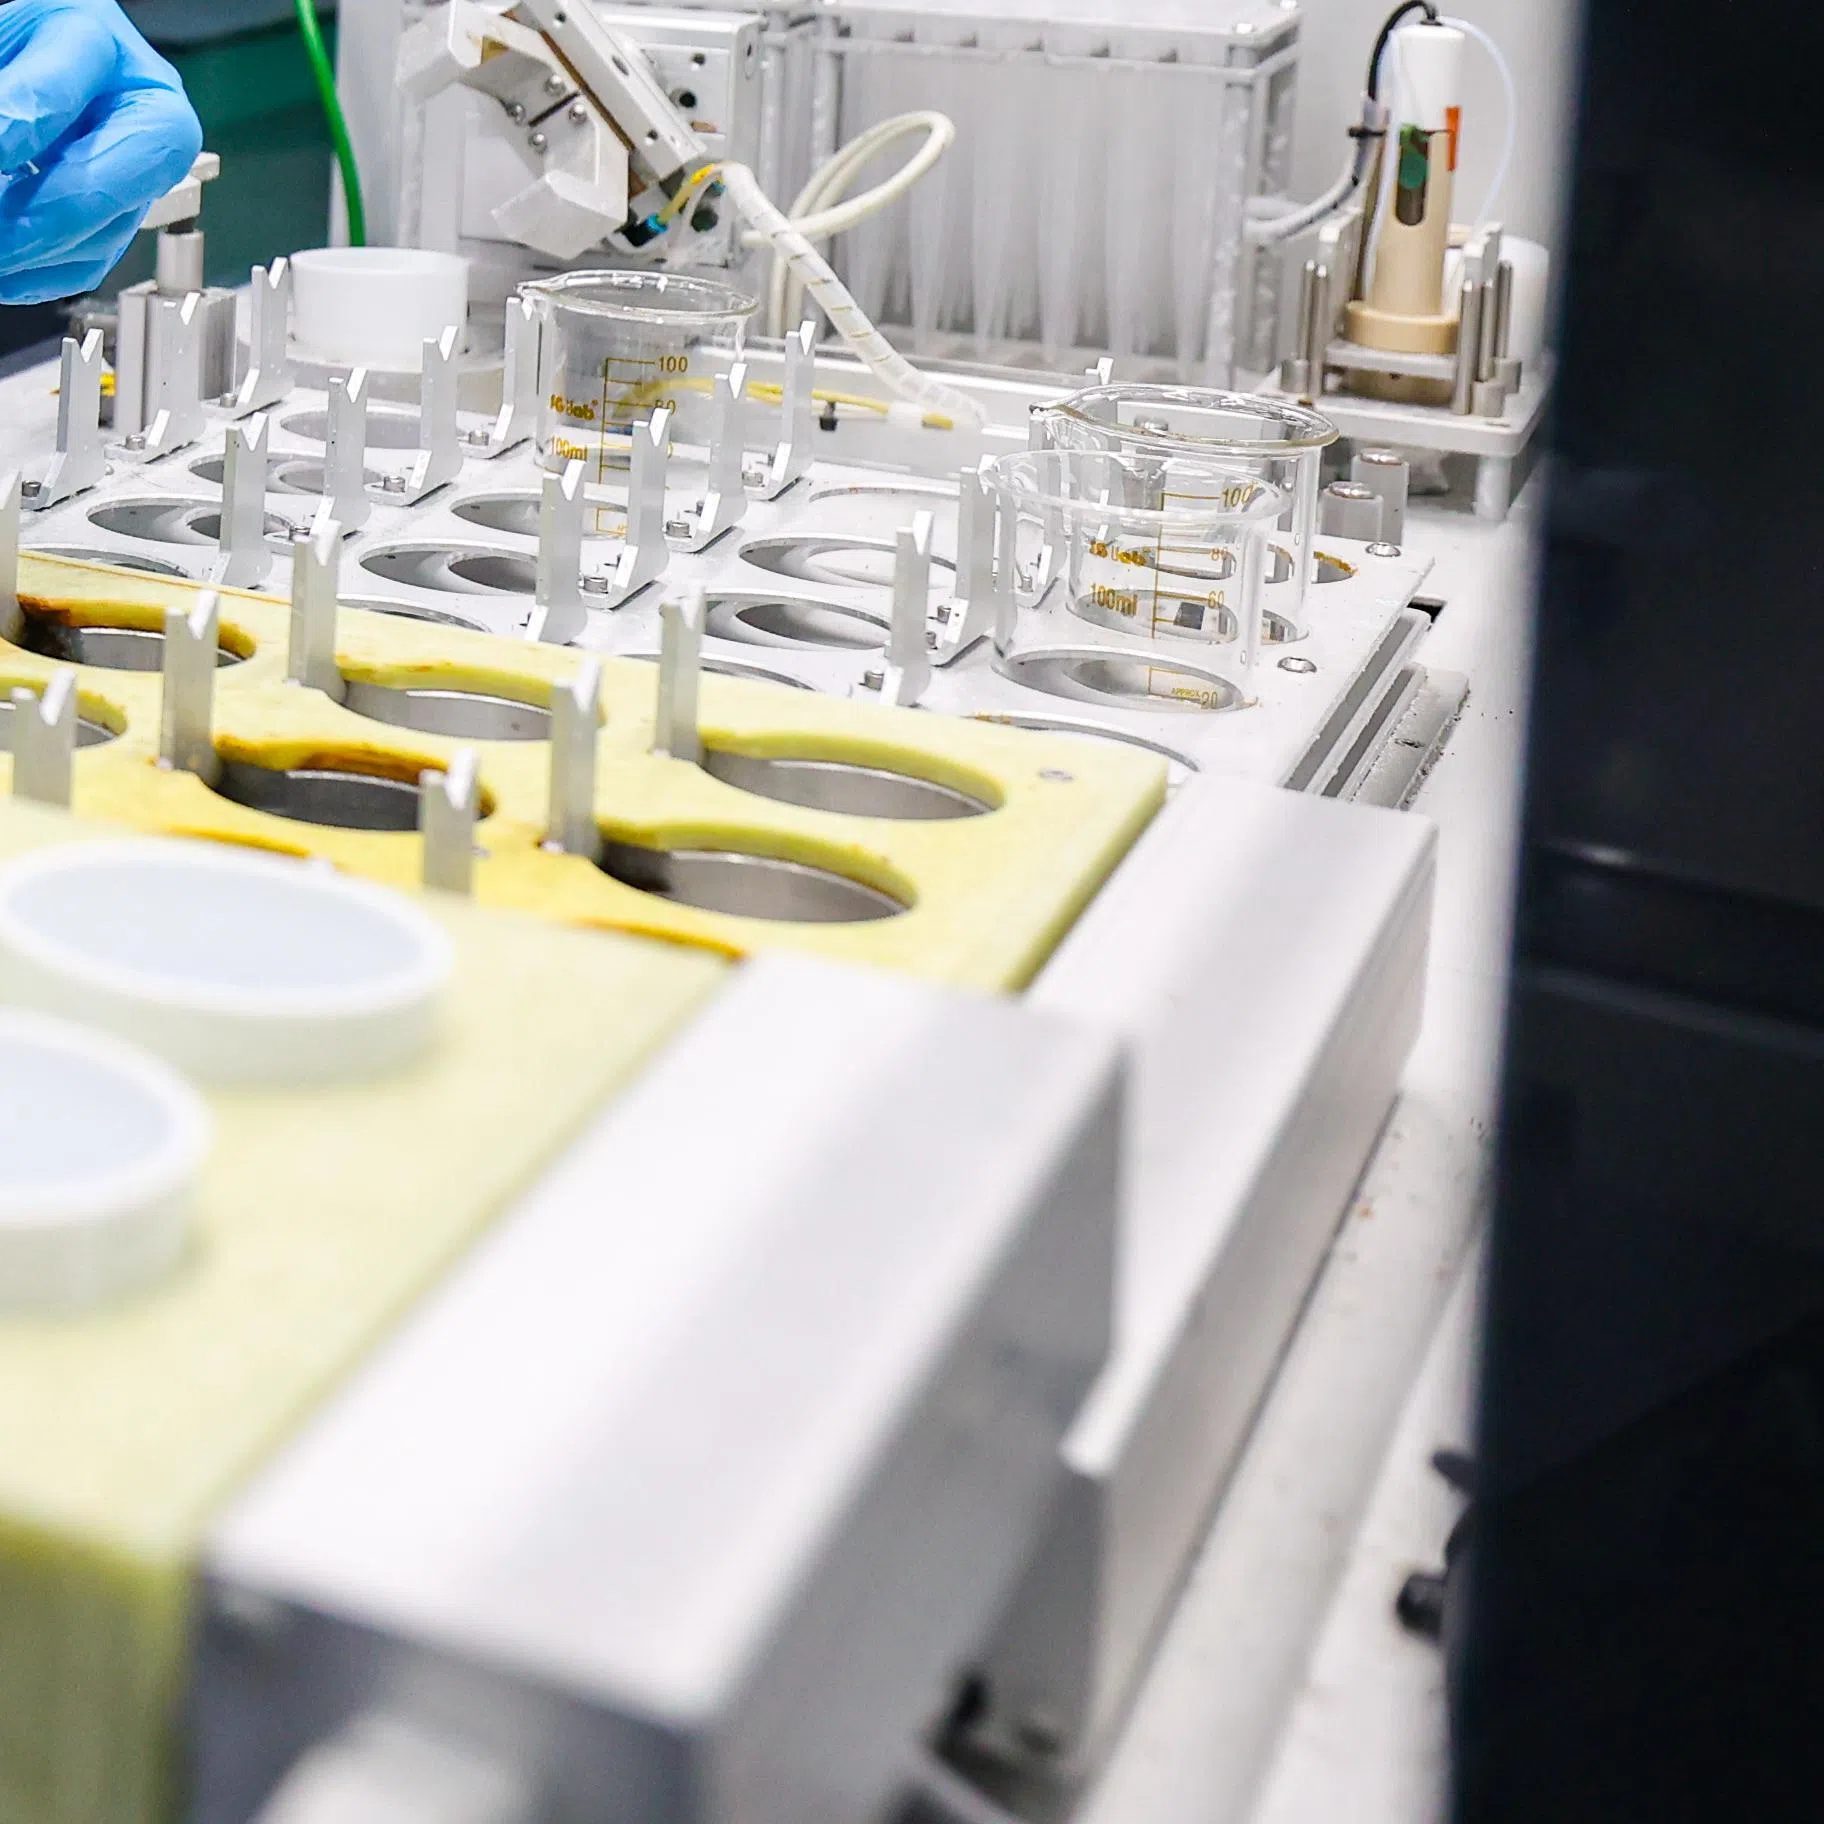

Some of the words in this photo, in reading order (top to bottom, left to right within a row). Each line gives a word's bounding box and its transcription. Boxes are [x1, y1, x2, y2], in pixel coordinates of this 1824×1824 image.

[658, 356, 688, 373] 100
[1090, 582, 1137, 617] 100ml
[1208, 590, 1225, 608] 60
[1200, 691, 1218, 710] 20
